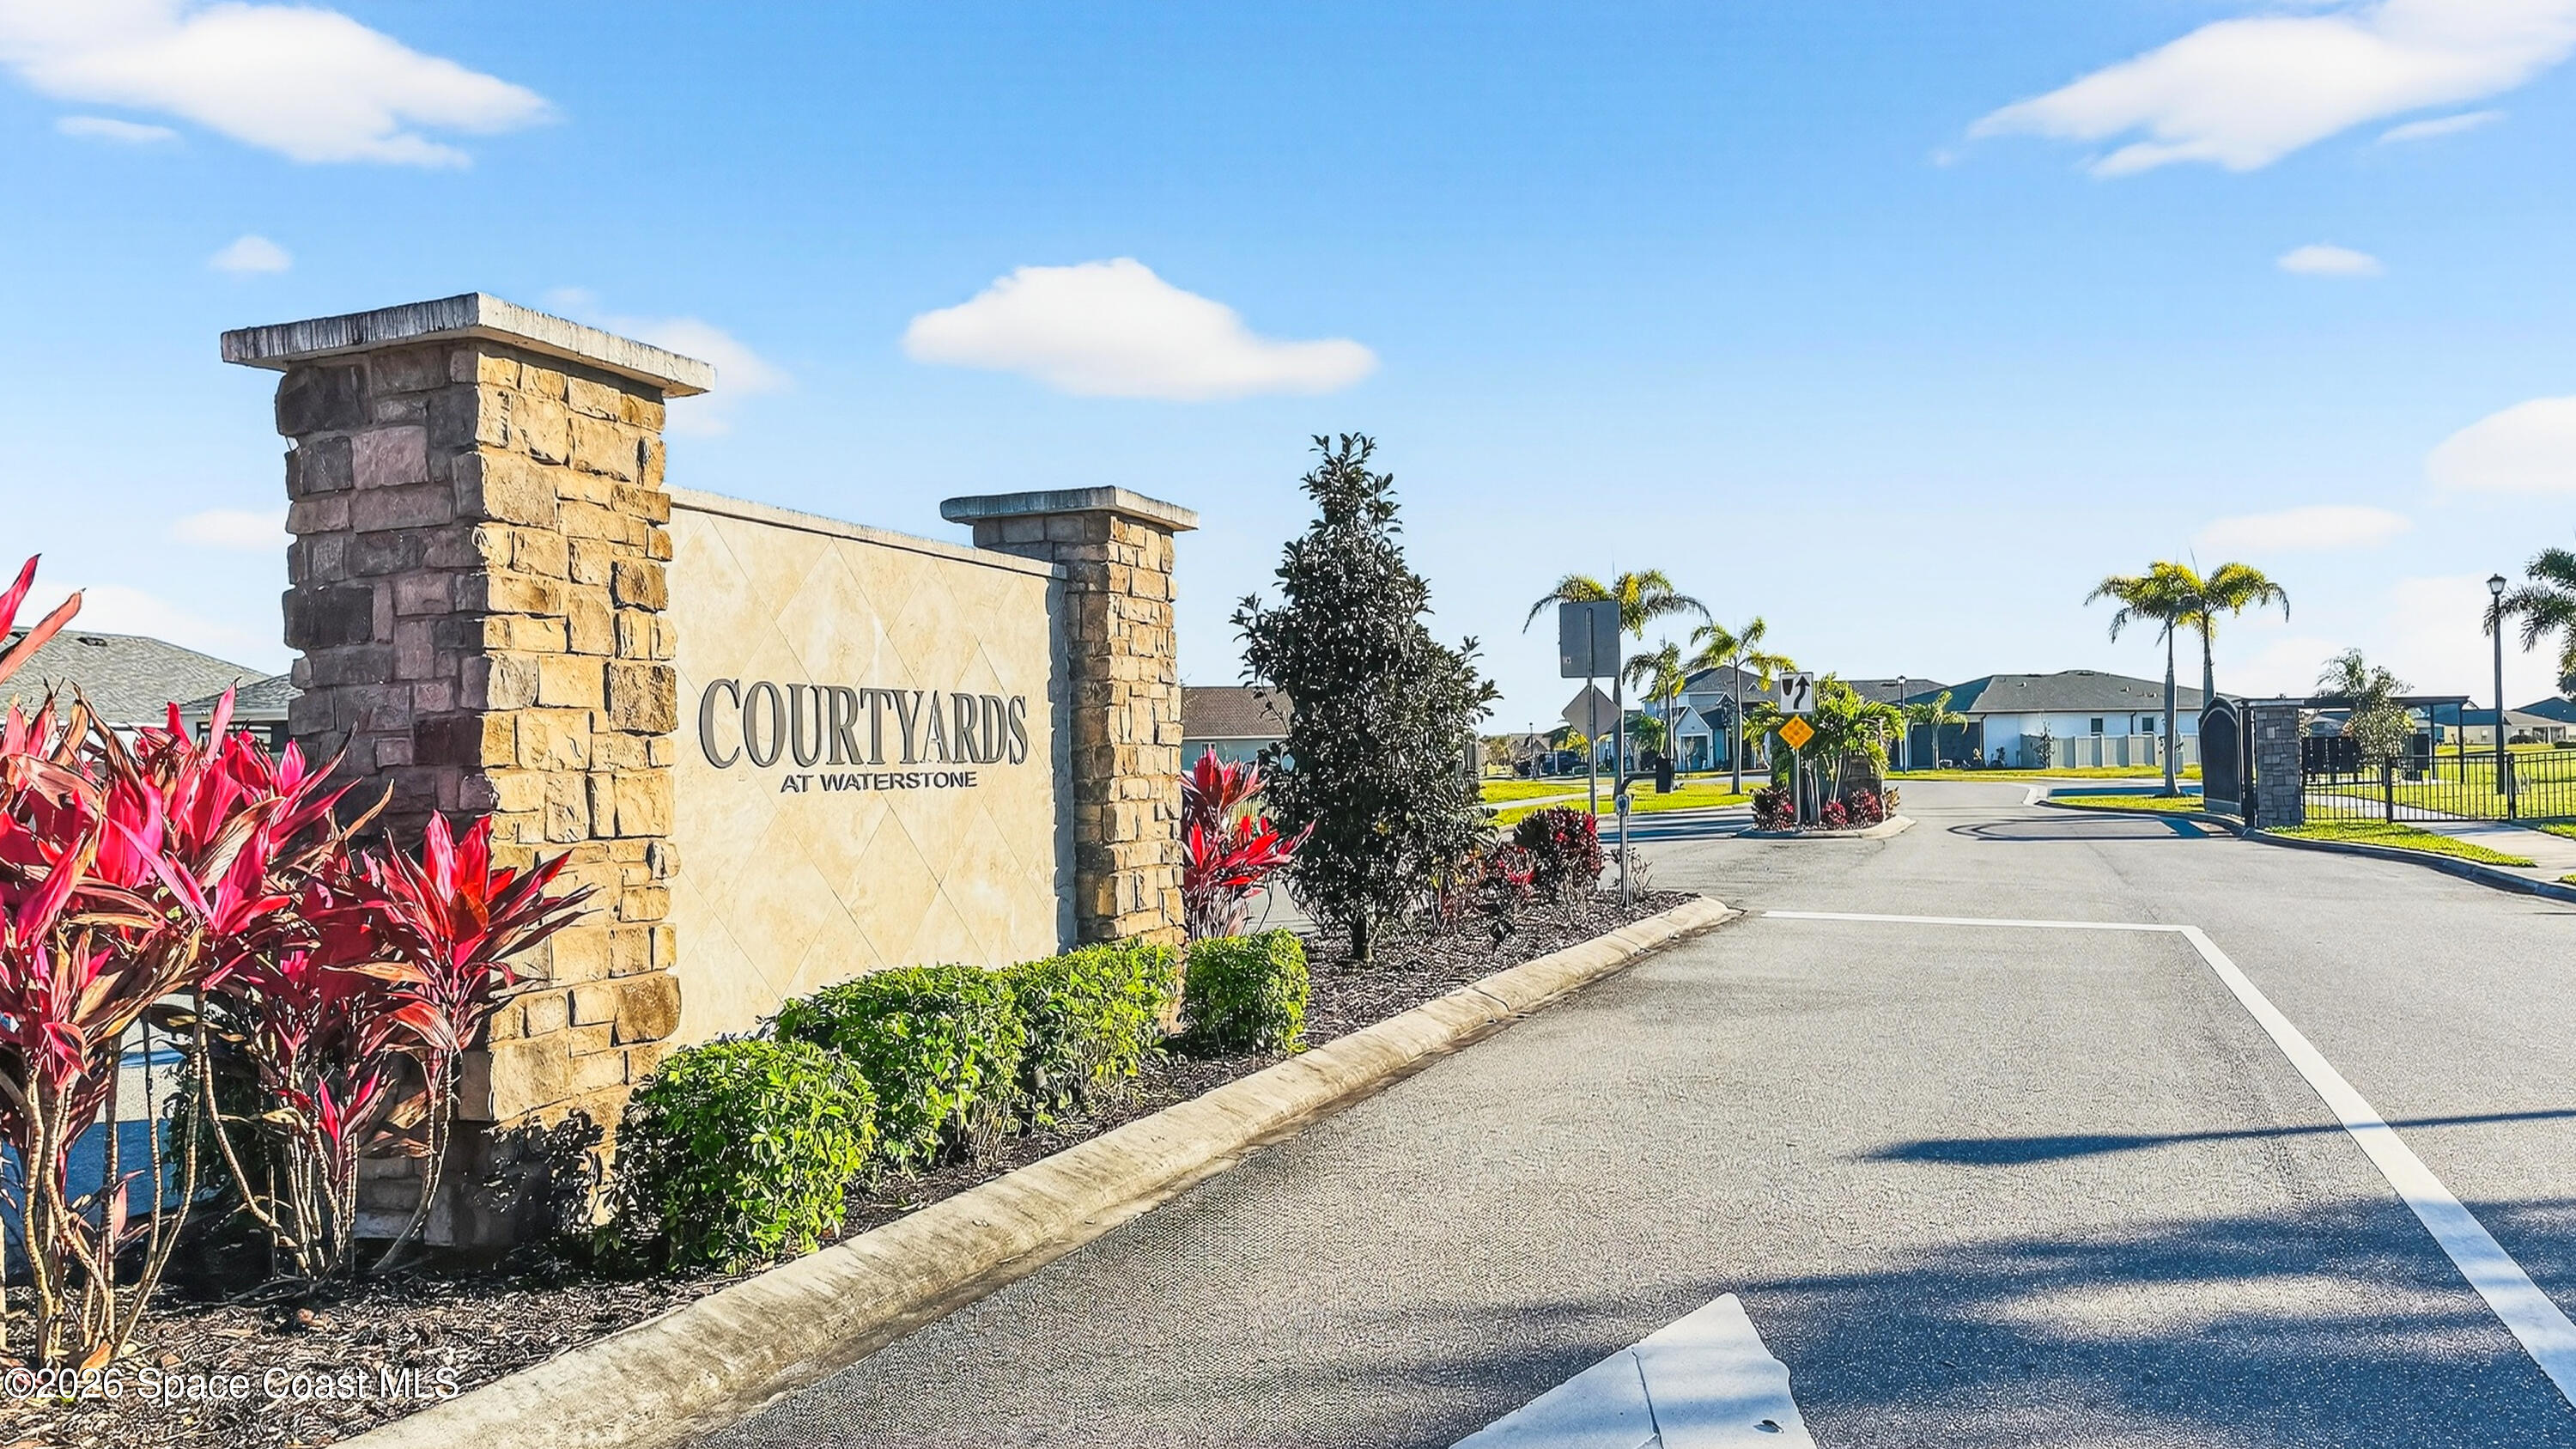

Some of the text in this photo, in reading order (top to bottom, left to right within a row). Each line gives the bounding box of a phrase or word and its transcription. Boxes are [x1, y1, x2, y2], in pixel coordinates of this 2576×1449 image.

[699, 678, 1029, 769] COURTYARDS
[781, 770, 978, 793] AT WATERSTONE
